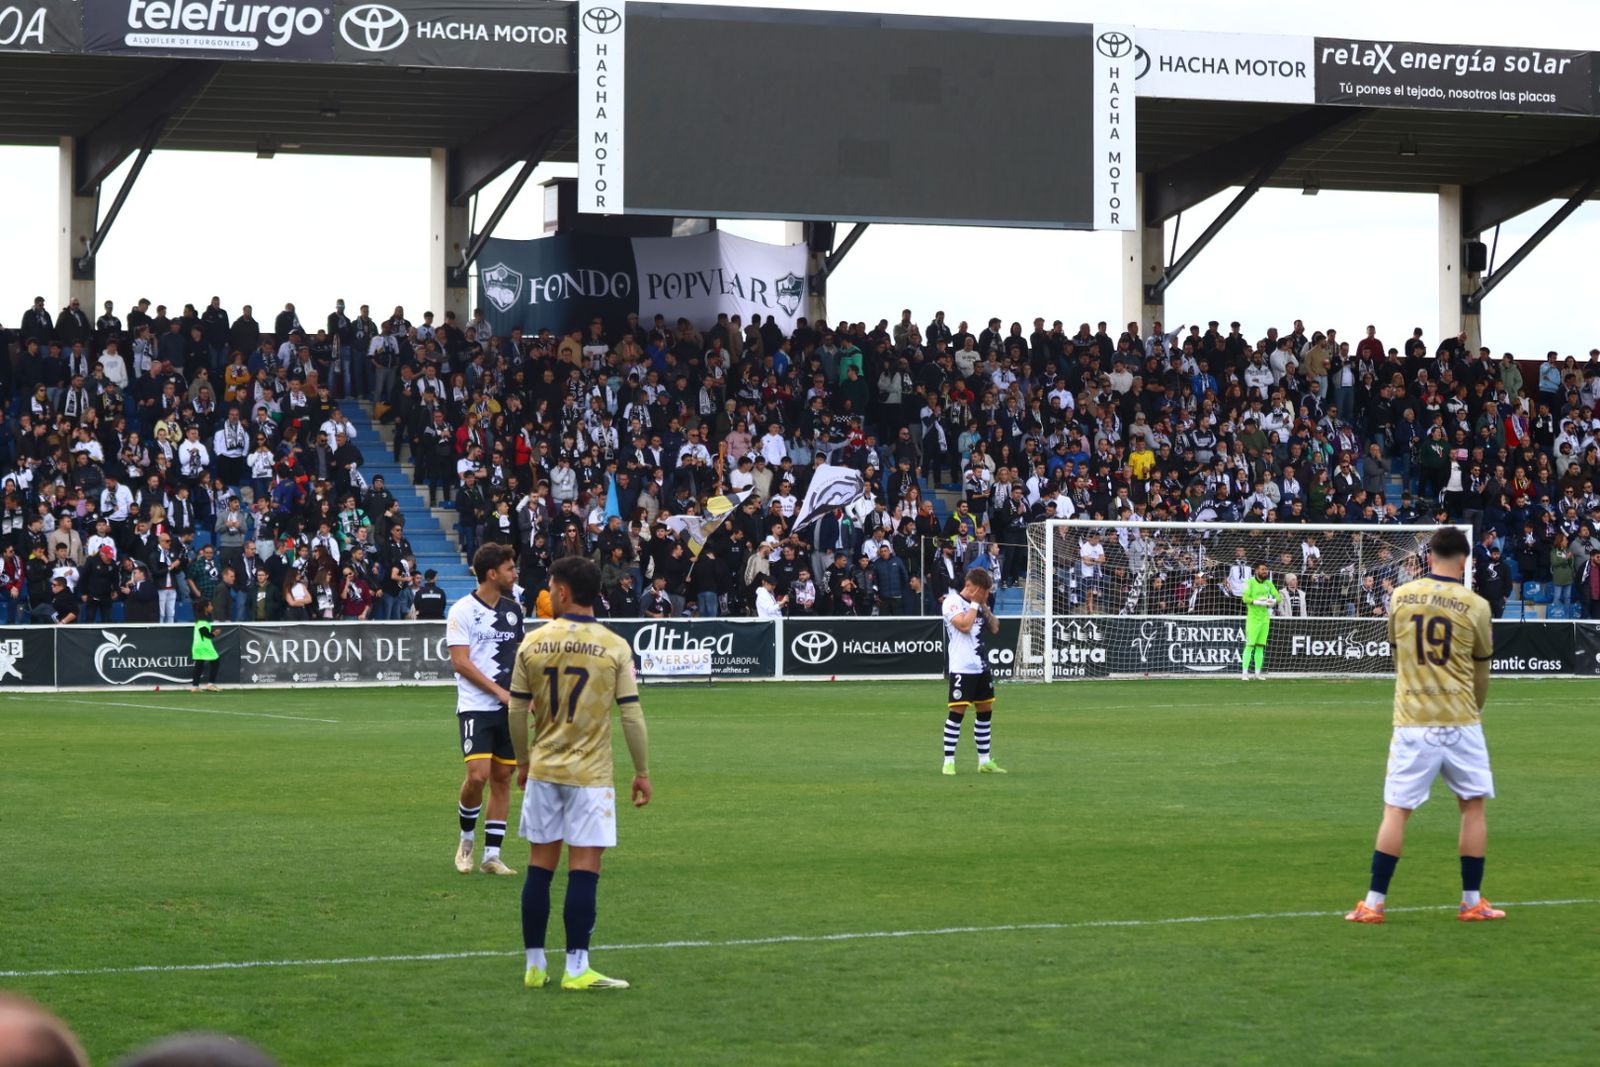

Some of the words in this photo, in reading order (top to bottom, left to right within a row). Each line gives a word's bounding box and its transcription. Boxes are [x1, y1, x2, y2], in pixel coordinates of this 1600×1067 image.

[133, 36, 176, 45] ALQUILER
[193, 39, 252, 48] FURGONETAS
[416, 21, 489, 41] HACHA
[493, 25, 568, 45] MOTOR
[1159, 55, 1230, 75] HACHA
[1235, 58, 1307, 78] MOTOR
[1400, 50, 1496, 76] energía
[1503, 52, 1571, 74] solar
[595, 43, 608, 120] HACHA
[1109, 66, 1120, 140] HACHA
[1339, 82, 1353, 94] Tú
[1356, 86, 1391, 97] pones
[1394, 85, 1404, 96] el
[1406, 86, 1447, 100] tejado,
[1448, 88, 1497, 100] nosotros
[1499, 90, 1517, 101] las
[1518, 91, 1556, 104] placas
[594, 131, 609, 208] MOTOR
[1108, 151, 1121, 224] MOTOR
[528, 268, 631, 304] FONDO
[1396, 594, 1428, 606] PABLO
[1431, 596, 1471, 614] MUÑOZ
[1164, 621, 1247, 642] TERNERA
[1410, 614, 1453, 666] 19
[245, 631, 362, 664] SARDÓN
[376, 637, 412, 662] DE
[534, 641, 561, 654] JAVI
[842, 640, 892, 654] HACHA
[894, 640, 943, 653] MOTOR
[1168, 643, 1244, 663] CHARRA
[656, 653, 709, 666] VERSUS
[726, 657, 760, 665] LABORAL
[1528, 657, 1562, 670] Grass
[954, 674, 962, 687] 2
[1015, 665, 1086, 677] Inmoliaria
[543, 666, 590, 724] 17
[464, 718, 475, 739] 11
